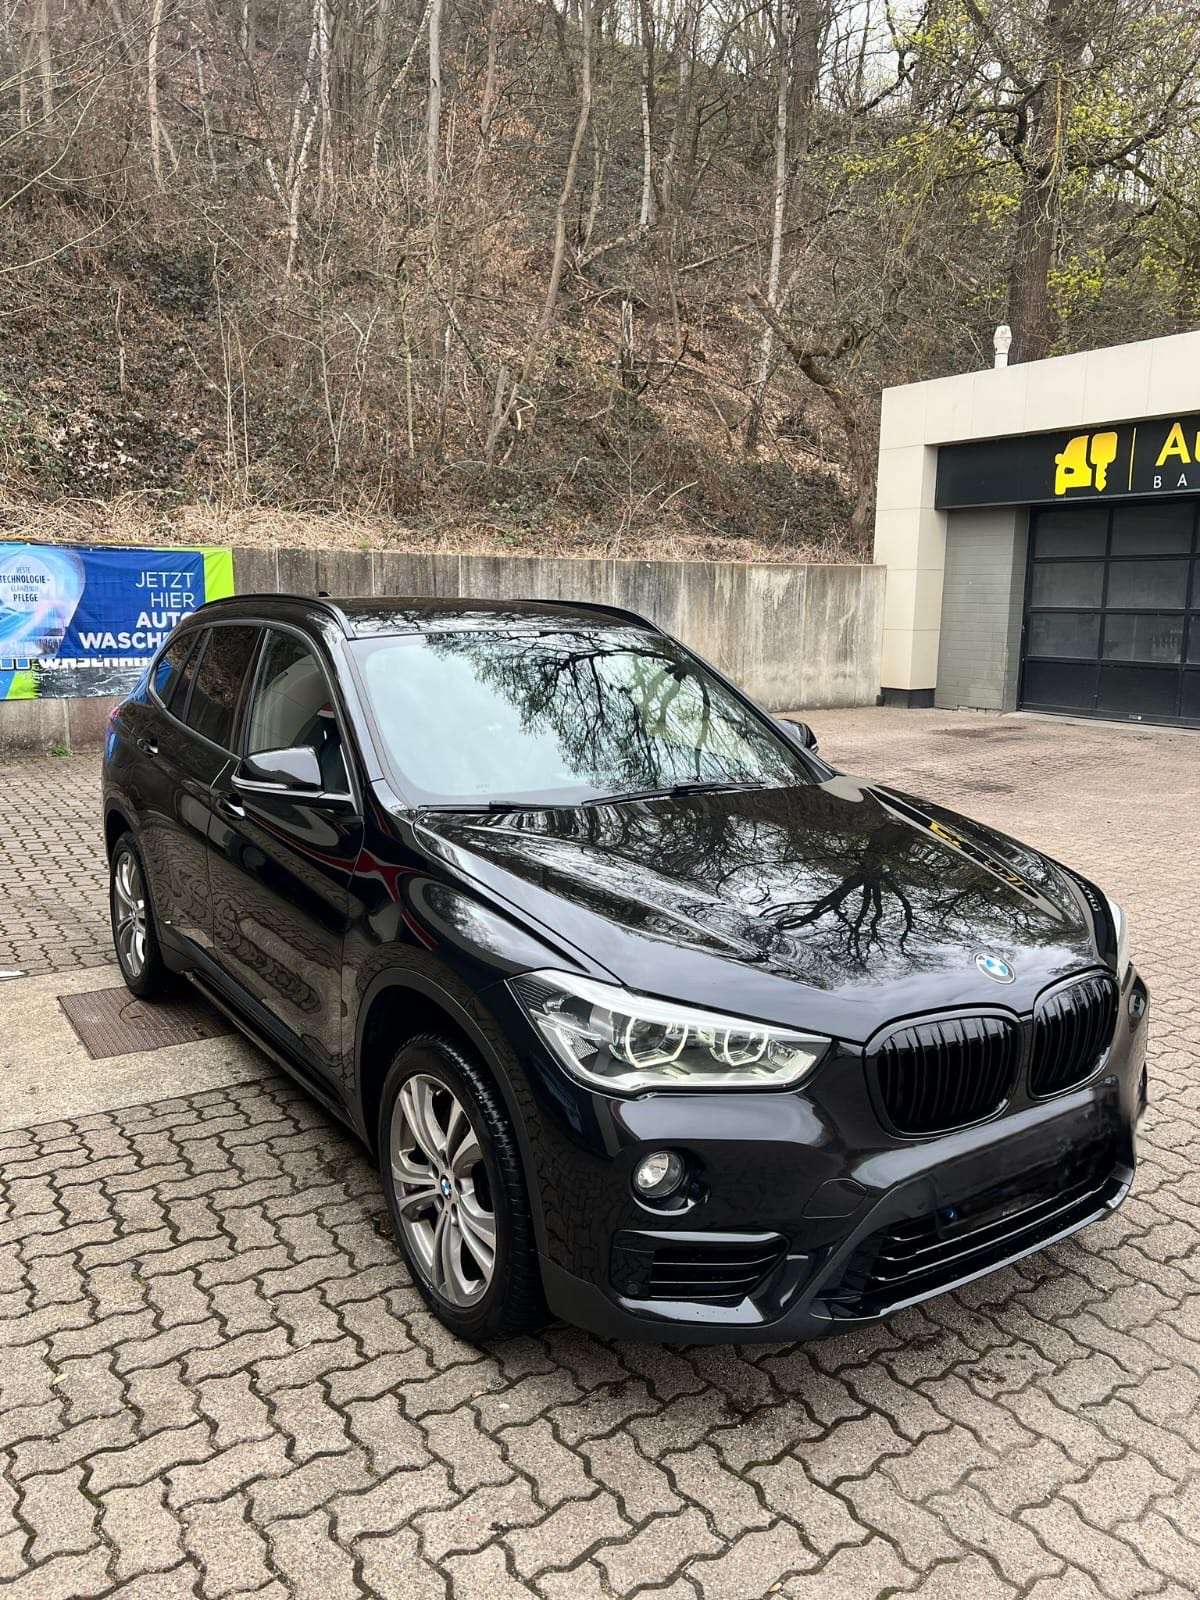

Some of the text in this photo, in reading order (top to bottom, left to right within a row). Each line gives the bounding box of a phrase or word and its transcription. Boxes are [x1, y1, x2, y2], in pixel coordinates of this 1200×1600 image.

[135, 571, 195, 589] JETZT
[13, 593, 39, 602] PFLEGE
[150, 592, 196, 608] HIER
